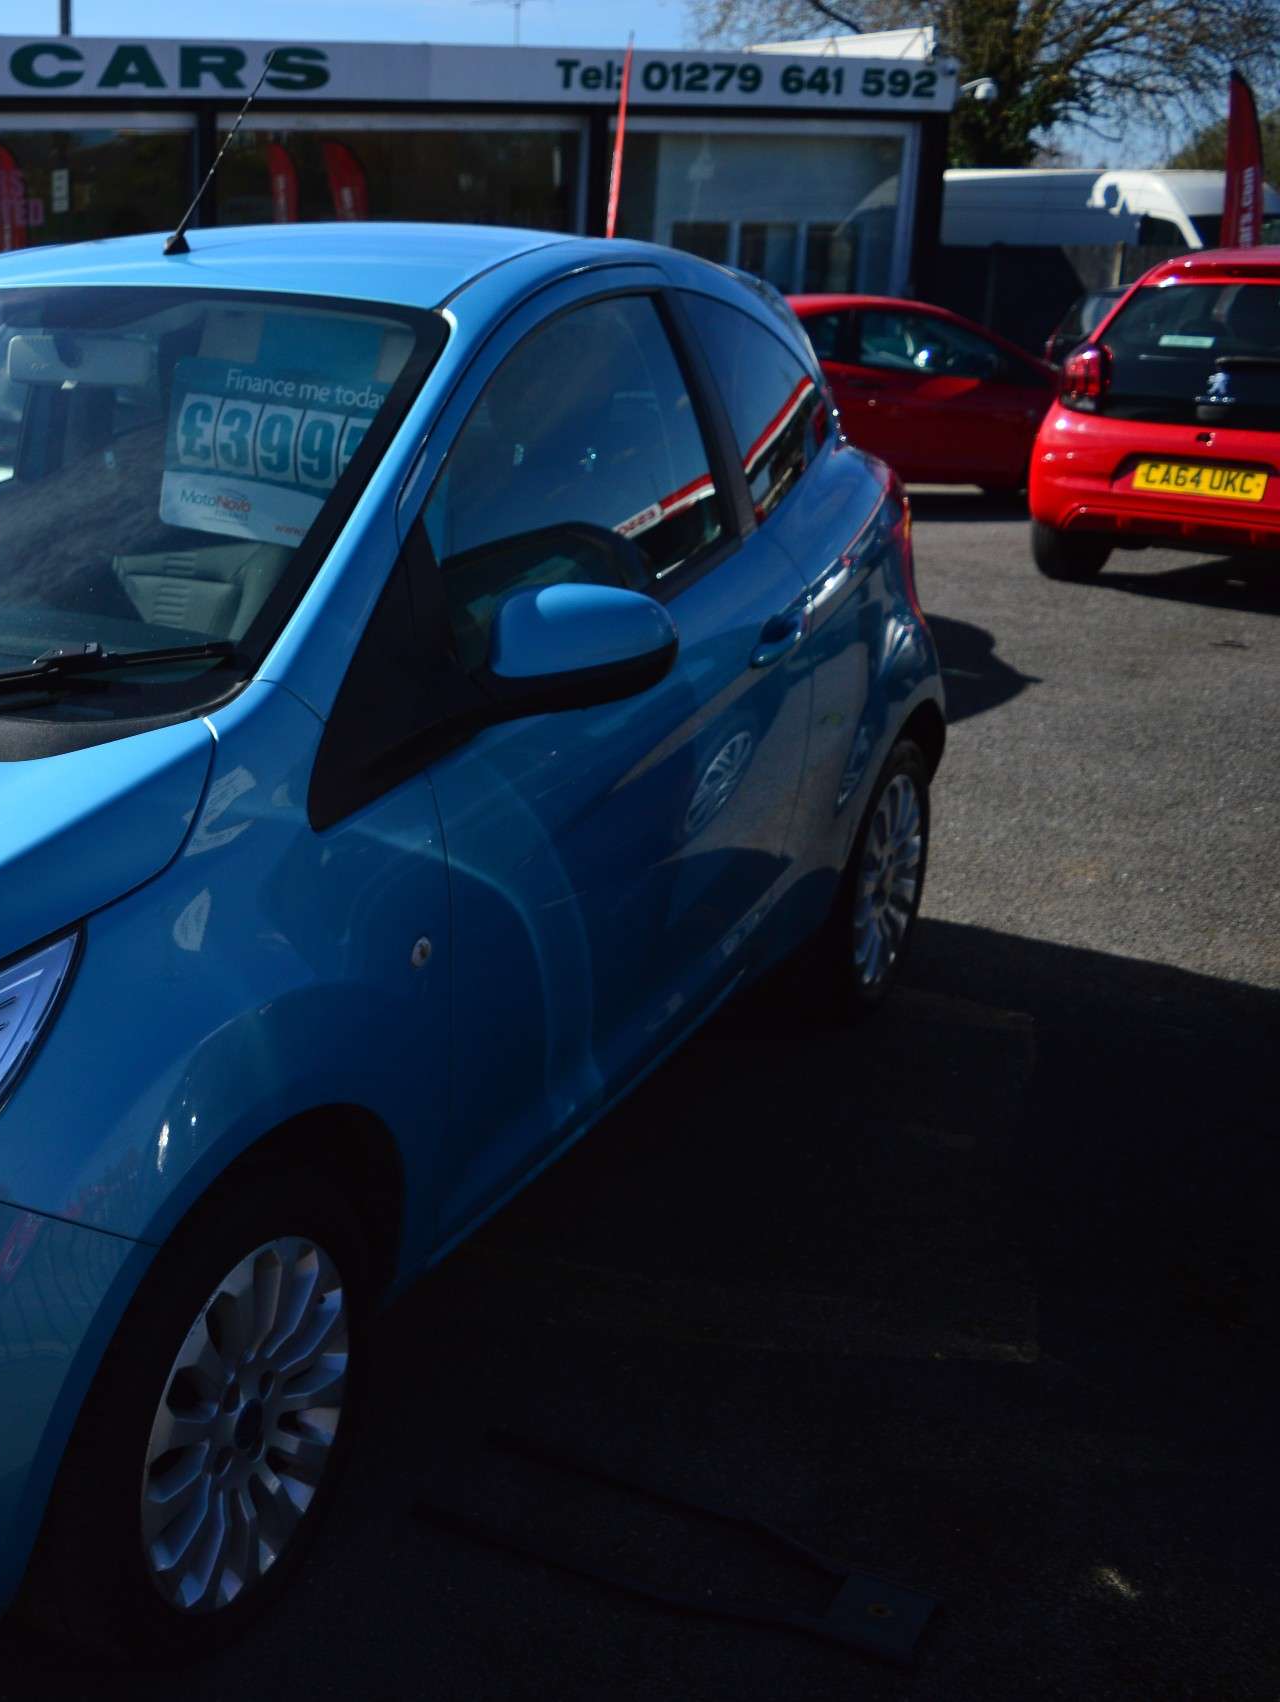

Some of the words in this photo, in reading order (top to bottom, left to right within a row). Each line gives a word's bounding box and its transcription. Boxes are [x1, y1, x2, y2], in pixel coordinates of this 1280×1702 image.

[9, 42, 330, 91] CARS
[556, 59, 624, 91] Tel:
[641, 61, 763, 93] 01279
[780, 65, 844, 96] 641
[860, 67, 938, 98] 592
[225, 367, 295, 397] Finance
[298, 382, 330, 402] me
[334, 384, 385, 409] toda
[1144, 463, 1203, 489] CA64
[1209, 467, 1256, 494] UKC
